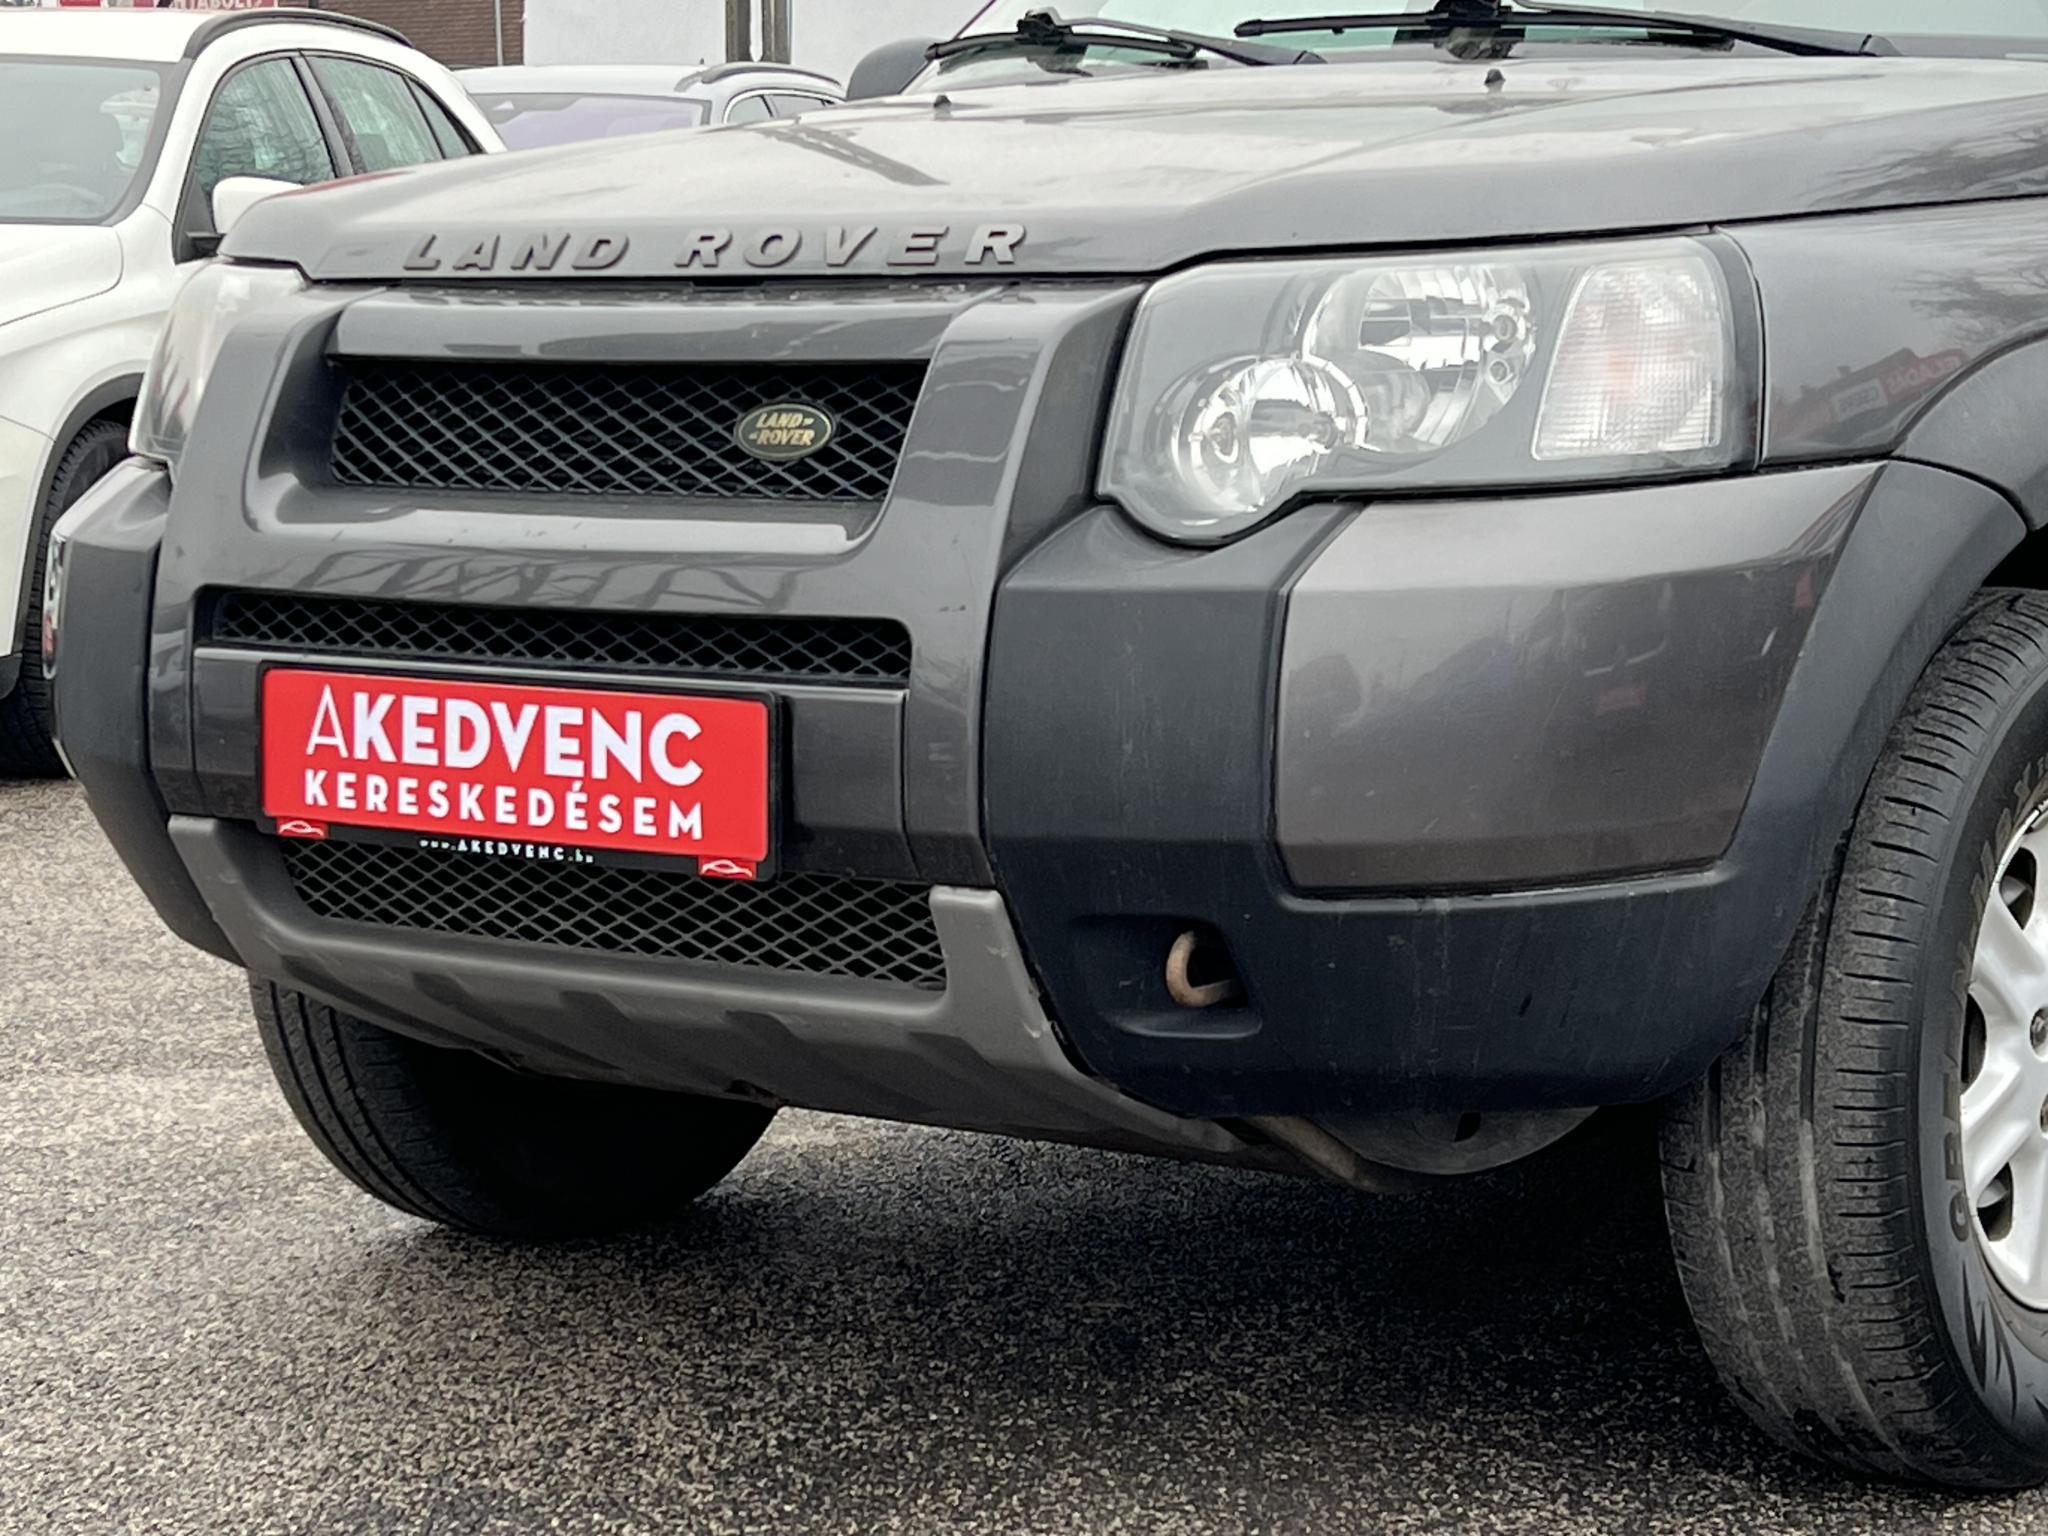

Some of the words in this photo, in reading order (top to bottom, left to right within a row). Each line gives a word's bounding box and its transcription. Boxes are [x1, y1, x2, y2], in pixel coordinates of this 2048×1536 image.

[402, 232, 630, 271] LAND
[674, 223, 1027, 267] ROVER
[306, 683, 703, 787] AKEDVENC
[304, 769, 703, 841] KERESKEDÉSEM
